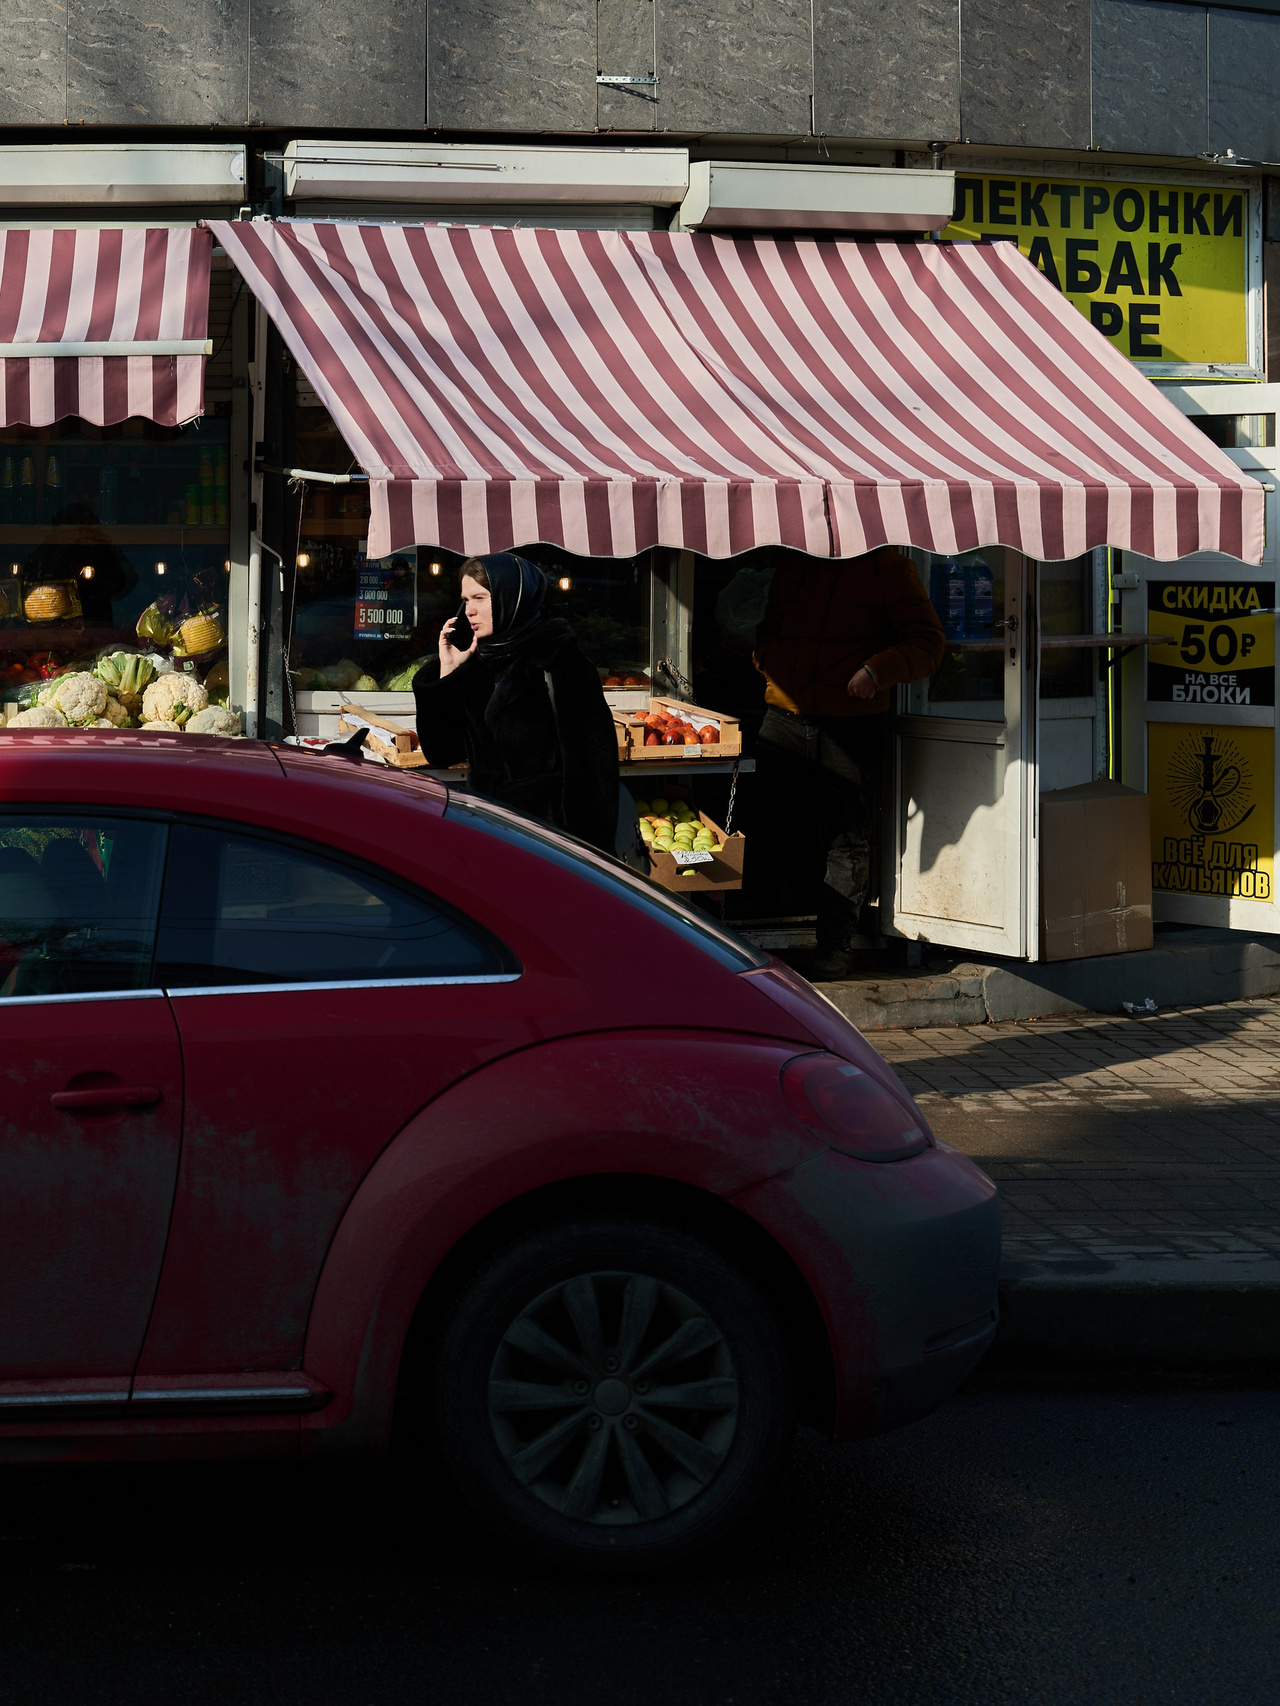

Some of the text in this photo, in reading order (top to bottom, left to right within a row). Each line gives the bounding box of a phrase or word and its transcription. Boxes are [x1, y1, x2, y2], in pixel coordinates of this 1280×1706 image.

[950, 178, 1243, 237] ЛЕКТРОНКИ
[981, 233, 1183, 297] АБАК
[1071, 301, 1162, 358] РЕ
[358, 590, 388, 600] 3 000 000
[1162, 585, 1261, 614] СКИДКА
[359, 608, 403, 624] 5 500 000
[1172, 685, 1251, 705] БЛОКИ
[1185, 673, 1237, 687] НА ВСЕ
[1164, 835, 1259, 872] ВСЁ ДЛЯ
[1152, 862, 1271, 899] КАЛЬЯНОВ
